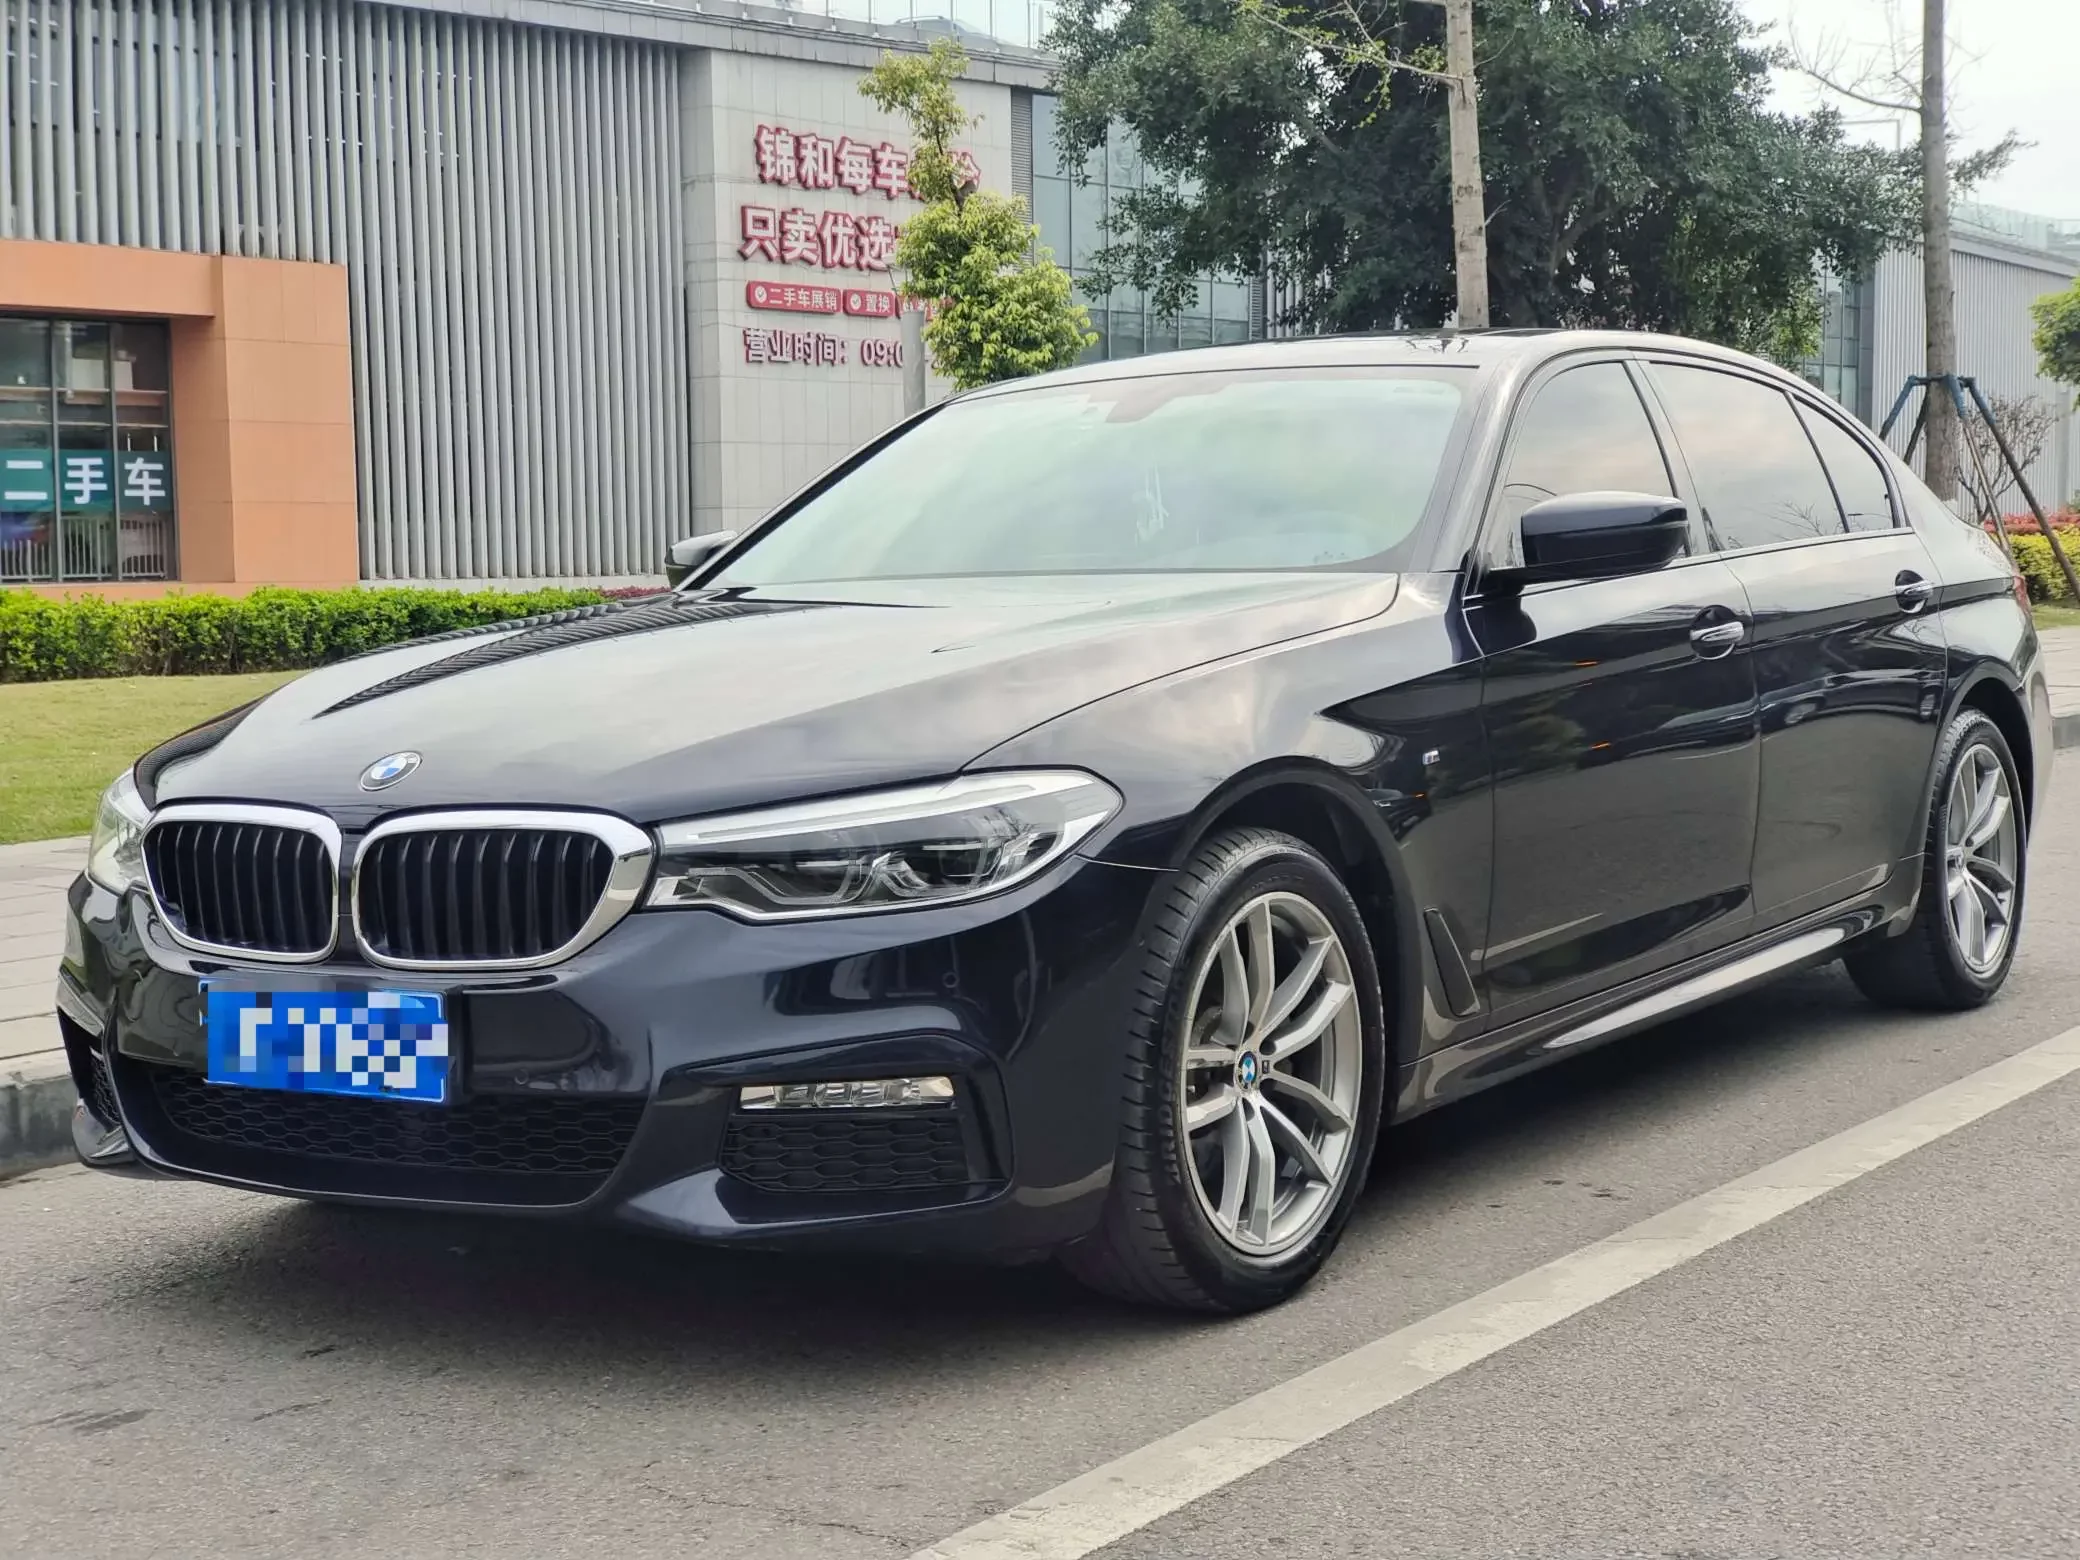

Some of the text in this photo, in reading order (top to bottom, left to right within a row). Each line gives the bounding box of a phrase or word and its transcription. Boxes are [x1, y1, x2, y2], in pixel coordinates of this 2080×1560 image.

[755, 125, 981, 200] 锦和每车
[738, 205, 899, 271] 只卖优选
[769, 287, 837, 312] 二手车展销
[865, 294, 891, 313] 置换
[861, 339, 903, 367] 09:0
[4, 457, 166, 506] 二手车
